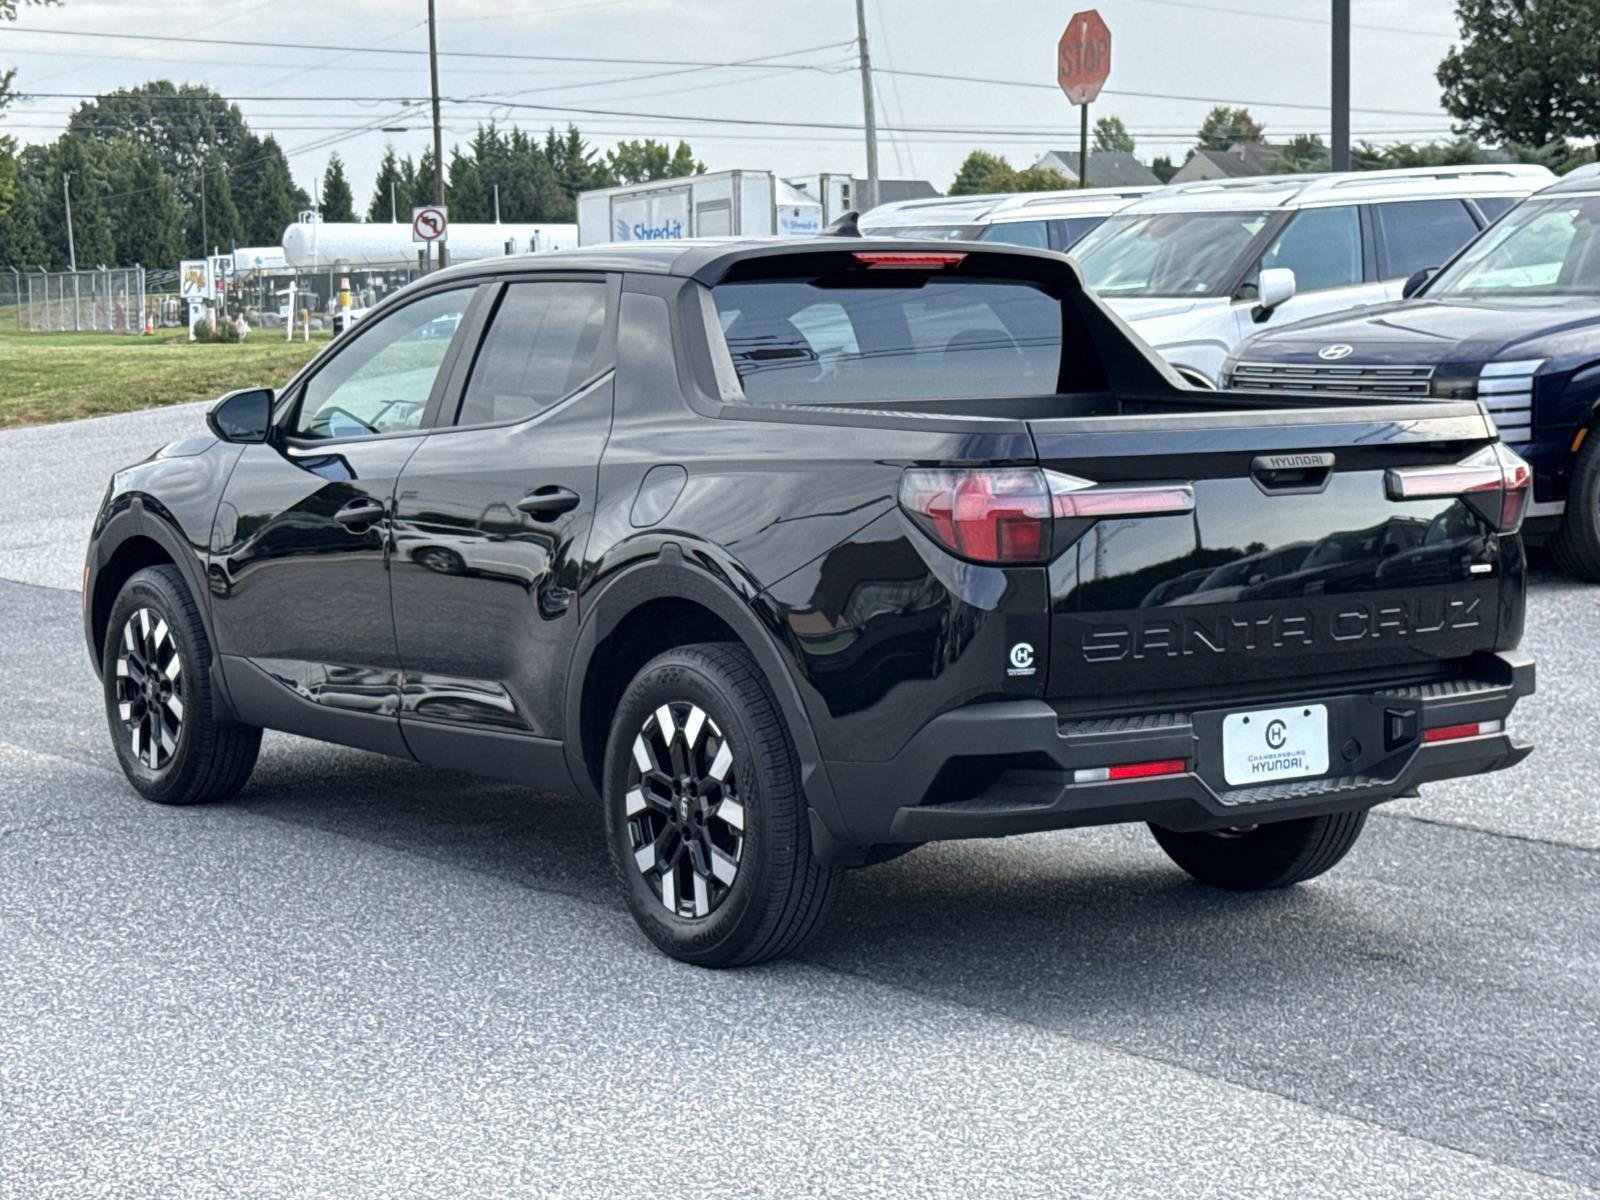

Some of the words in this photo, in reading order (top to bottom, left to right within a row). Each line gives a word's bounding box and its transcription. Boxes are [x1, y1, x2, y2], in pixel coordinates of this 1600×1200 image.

[1061, 38, 1107, 77] STOP
[633, 219, 682, 239] Shred-it
[1270, 455, 1324, 468] HYUNDAI
[1082, 608, 1314, 663] SANTA
[1329, 595, 1482, 641] CRUZ
[1252, 758, 1302, 773] HYUNDAI
